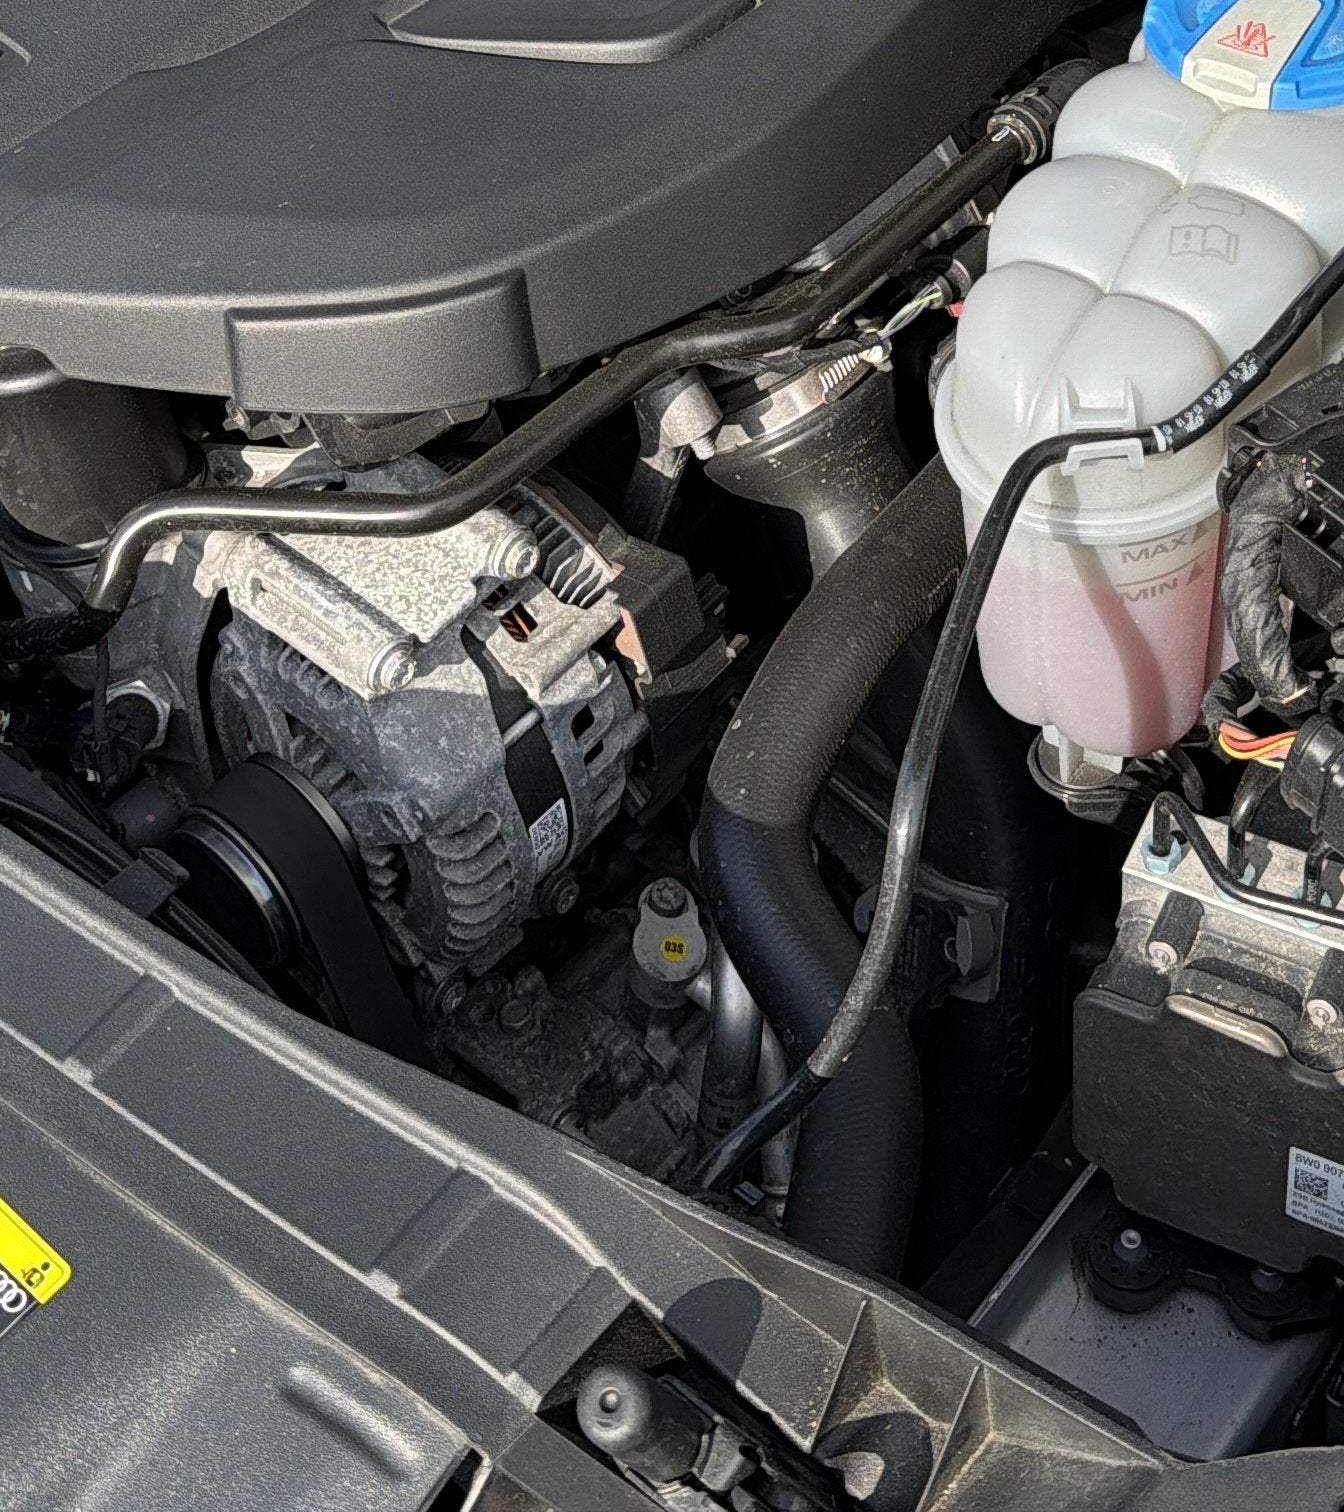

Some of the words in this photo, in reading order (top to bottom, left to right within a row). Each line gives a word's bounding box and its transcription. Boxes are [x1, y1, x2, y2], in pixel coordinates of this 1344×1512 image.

[1121, 534, 1187, 563] MAX
[1119, 577, 1178, 604] MIN
[1295, 1152, 1320, 1170] 8W0
[1323, 1163, 1343, 1178] 907
